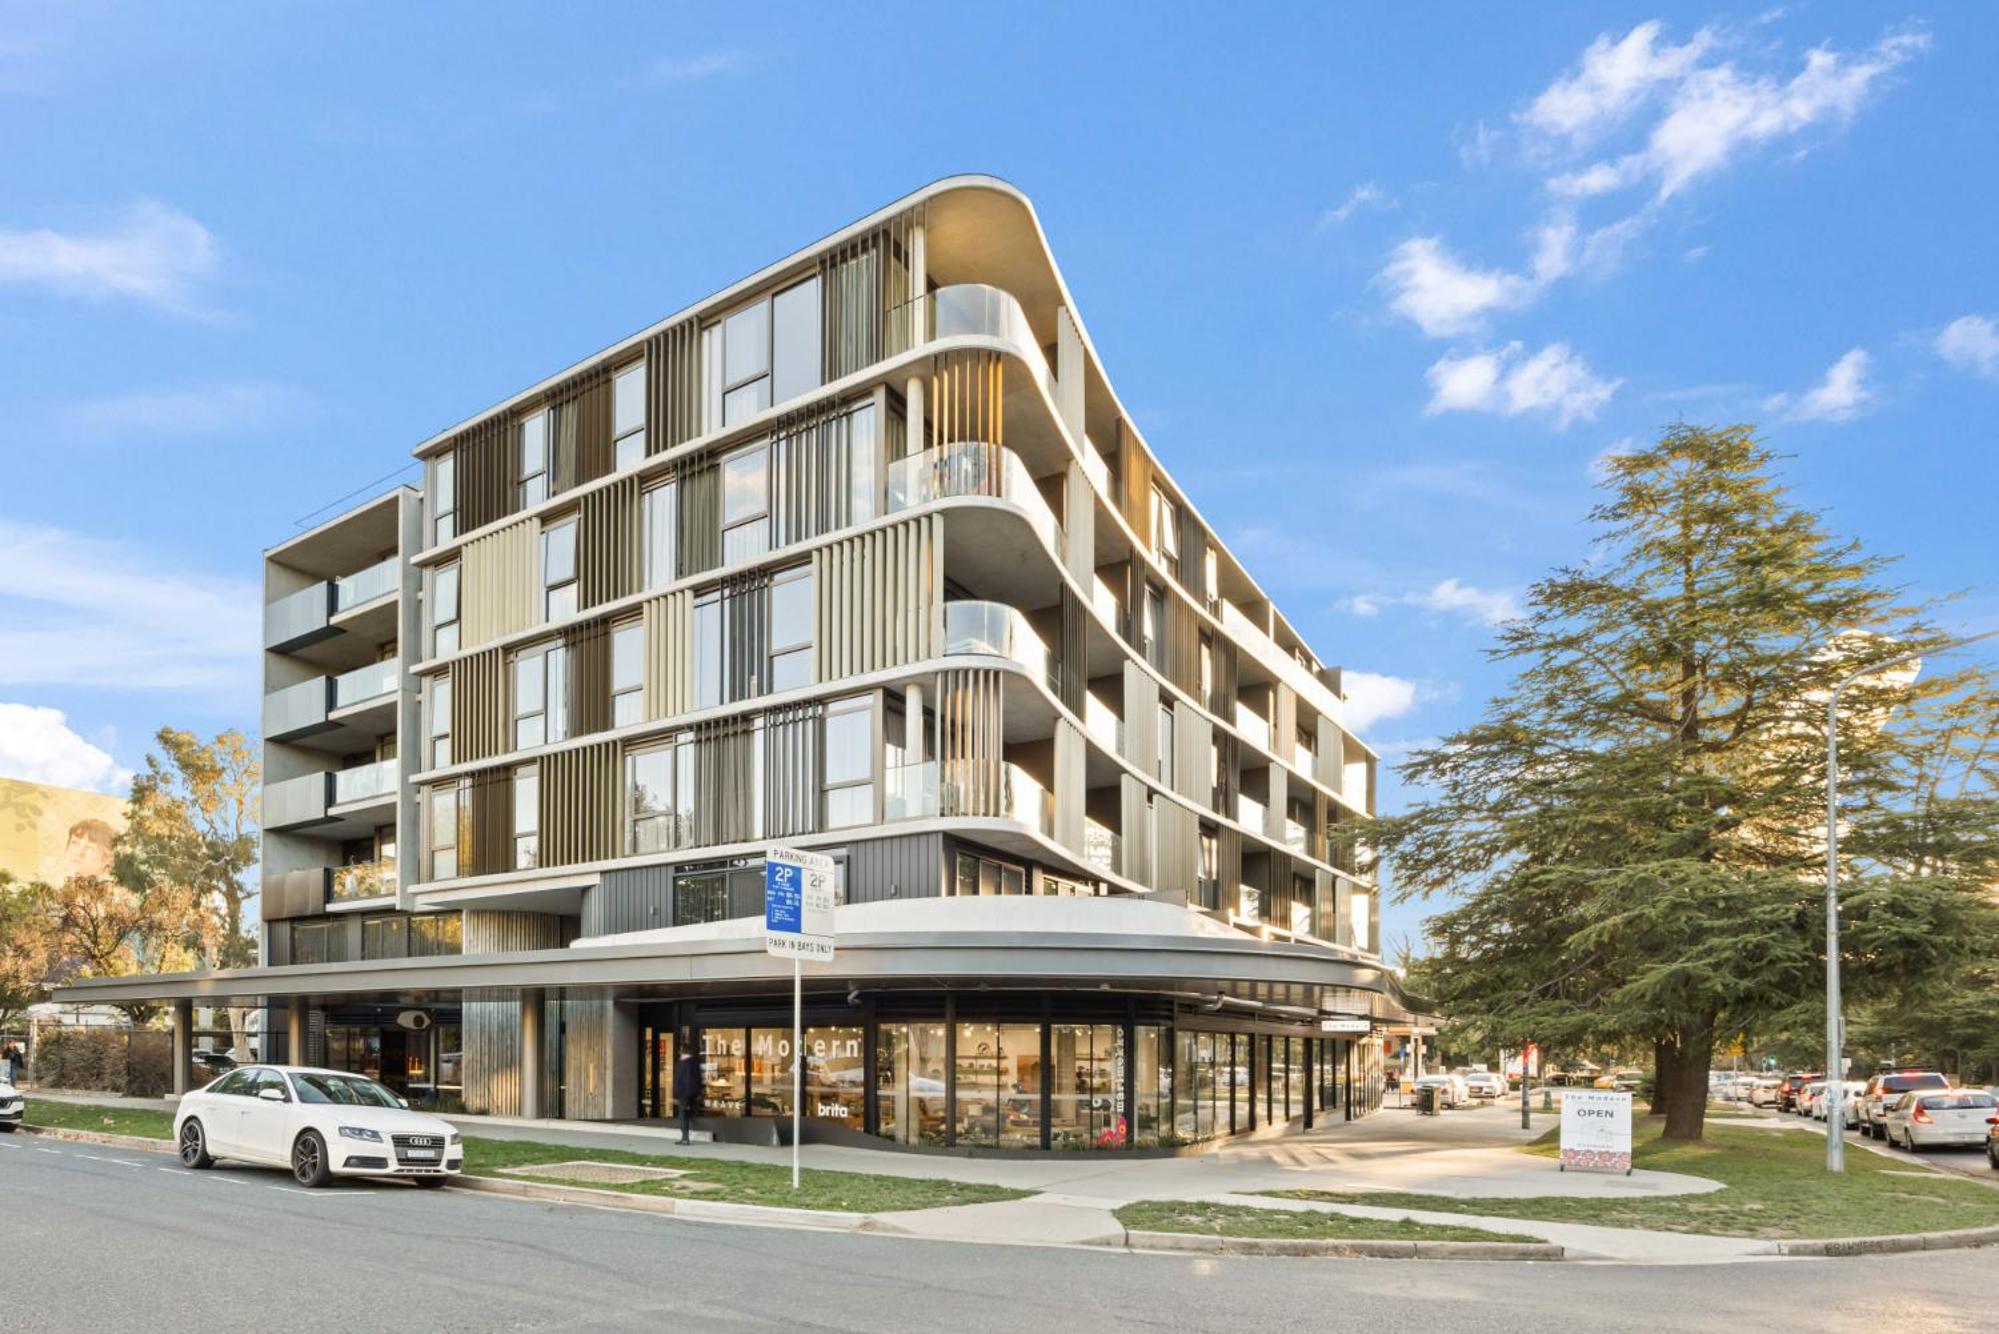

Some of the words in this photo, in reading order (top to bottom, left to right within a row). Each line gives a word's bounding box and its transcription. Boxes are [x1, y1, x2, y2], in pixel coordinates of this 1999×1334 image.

[774, 849, 807, 864] PARKING
[775, 866, 793, 883] 2P
[810, 873, 826, 888] 2P
[769, 938, 786, 949] PARK
[788, 940, 796, 950] IN
[797, 941, 814, 952] BAYS
[816, 943, 832, 954] ONLY
[702, 1034, 742, 1056] The
[1115, 1028, 1124, 1112] marimekko
[704, 1099, 741, 1110] WEAVE
[818, 1103, 848, 1118] brita
[1577, 1108, 1615, 1118] OPEN
